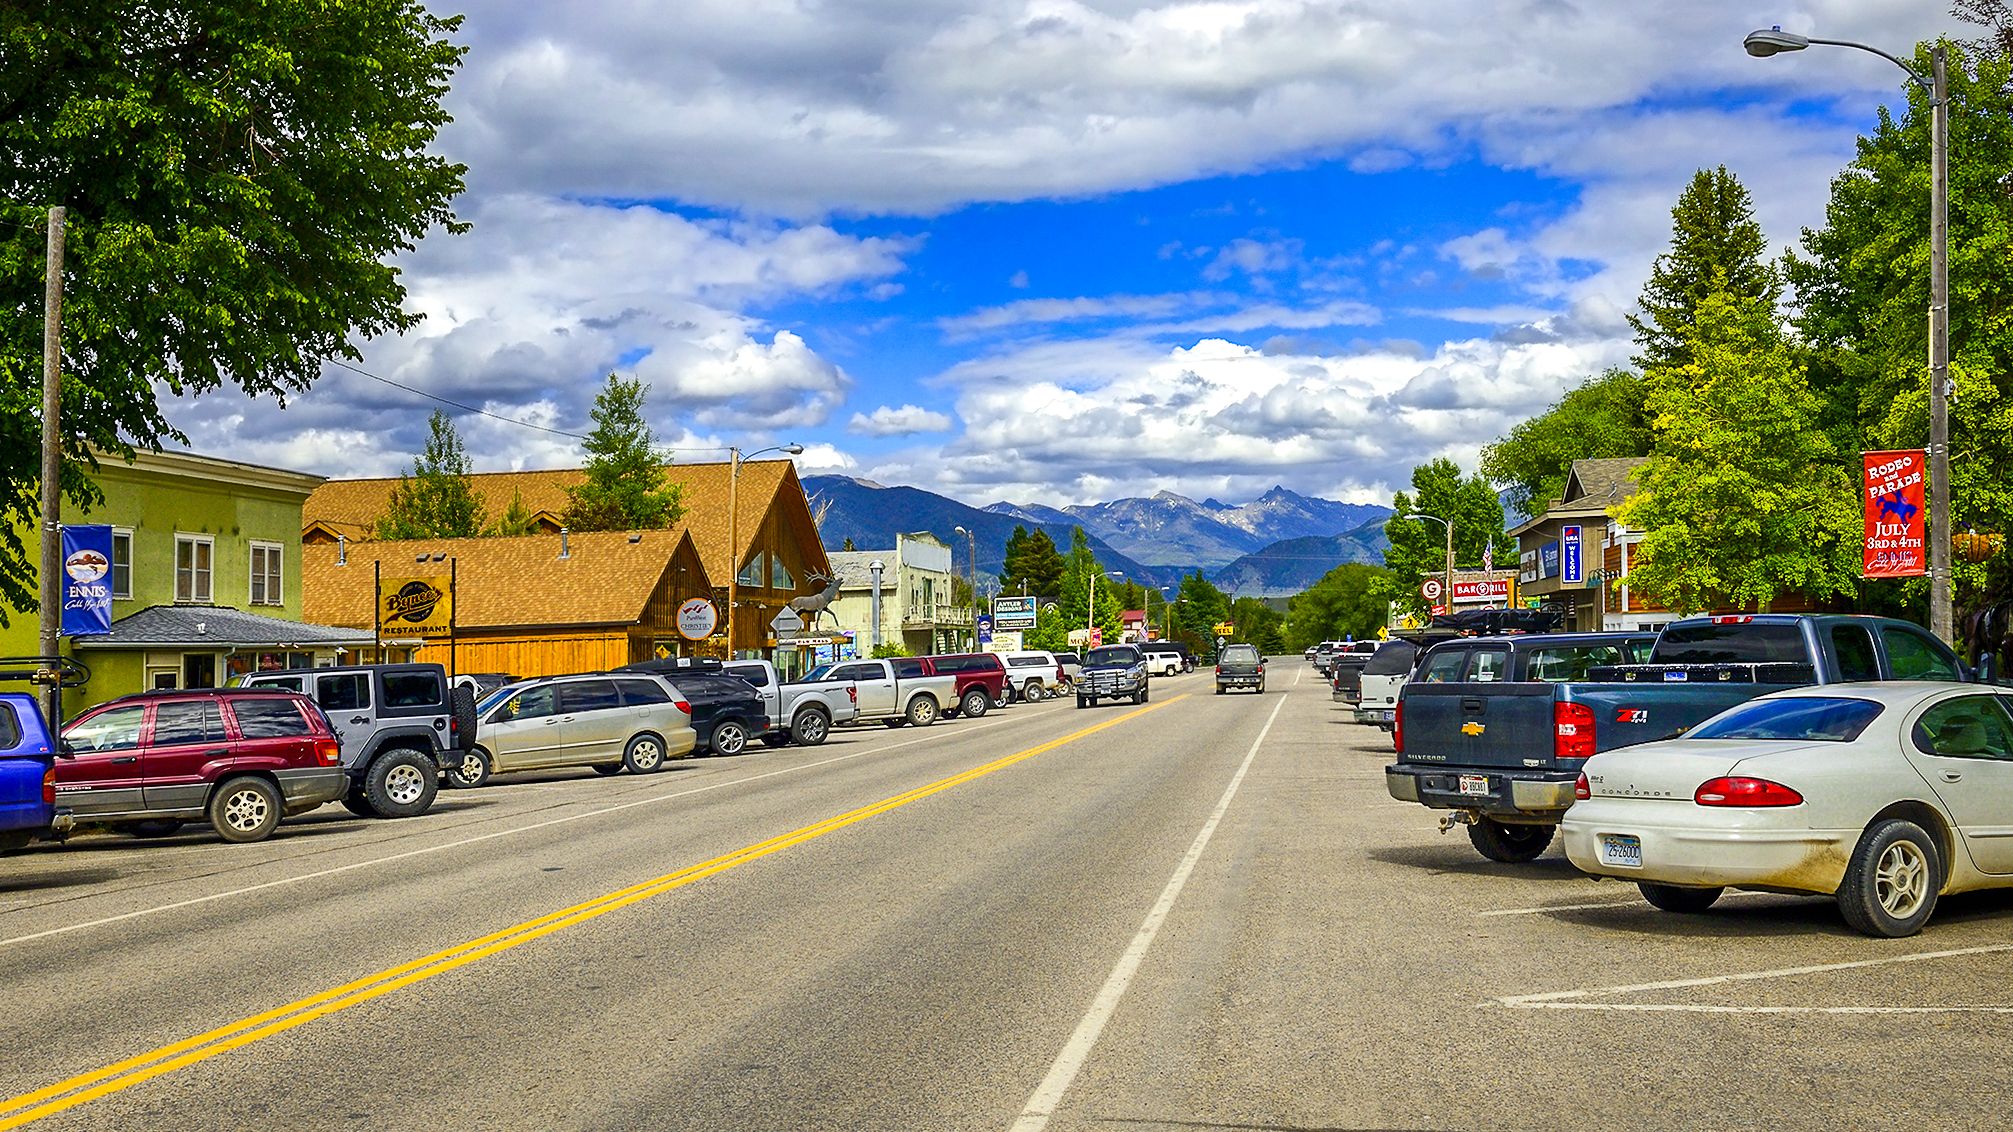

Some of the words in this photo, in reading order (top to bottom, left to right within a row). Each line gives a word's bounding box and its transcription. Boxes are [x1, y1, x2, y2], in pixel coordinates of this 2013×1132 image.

[1868, 456, 1912, 480] RODEO
[1884, 471, 1898, 482] and
[1868, 471, 1921, 499] PARADE
[1875, 521, 1911, 539] JULY
[1866, 536, 1890, 549] 3RD
[1891, 540, 1897, 548] &
[1898, 536, 1921, 548] 4TH
[1568, 546, 1576, 580] WELCOME
[69, 586, 106, 597] ENNIS
[1426, 583, 1437, 592] G
[1457, 586, 1476, 594] BAR
[384, 626, 448, 634] RESTAURANT
[1601, 788, 1671, 797] CONCORDE
